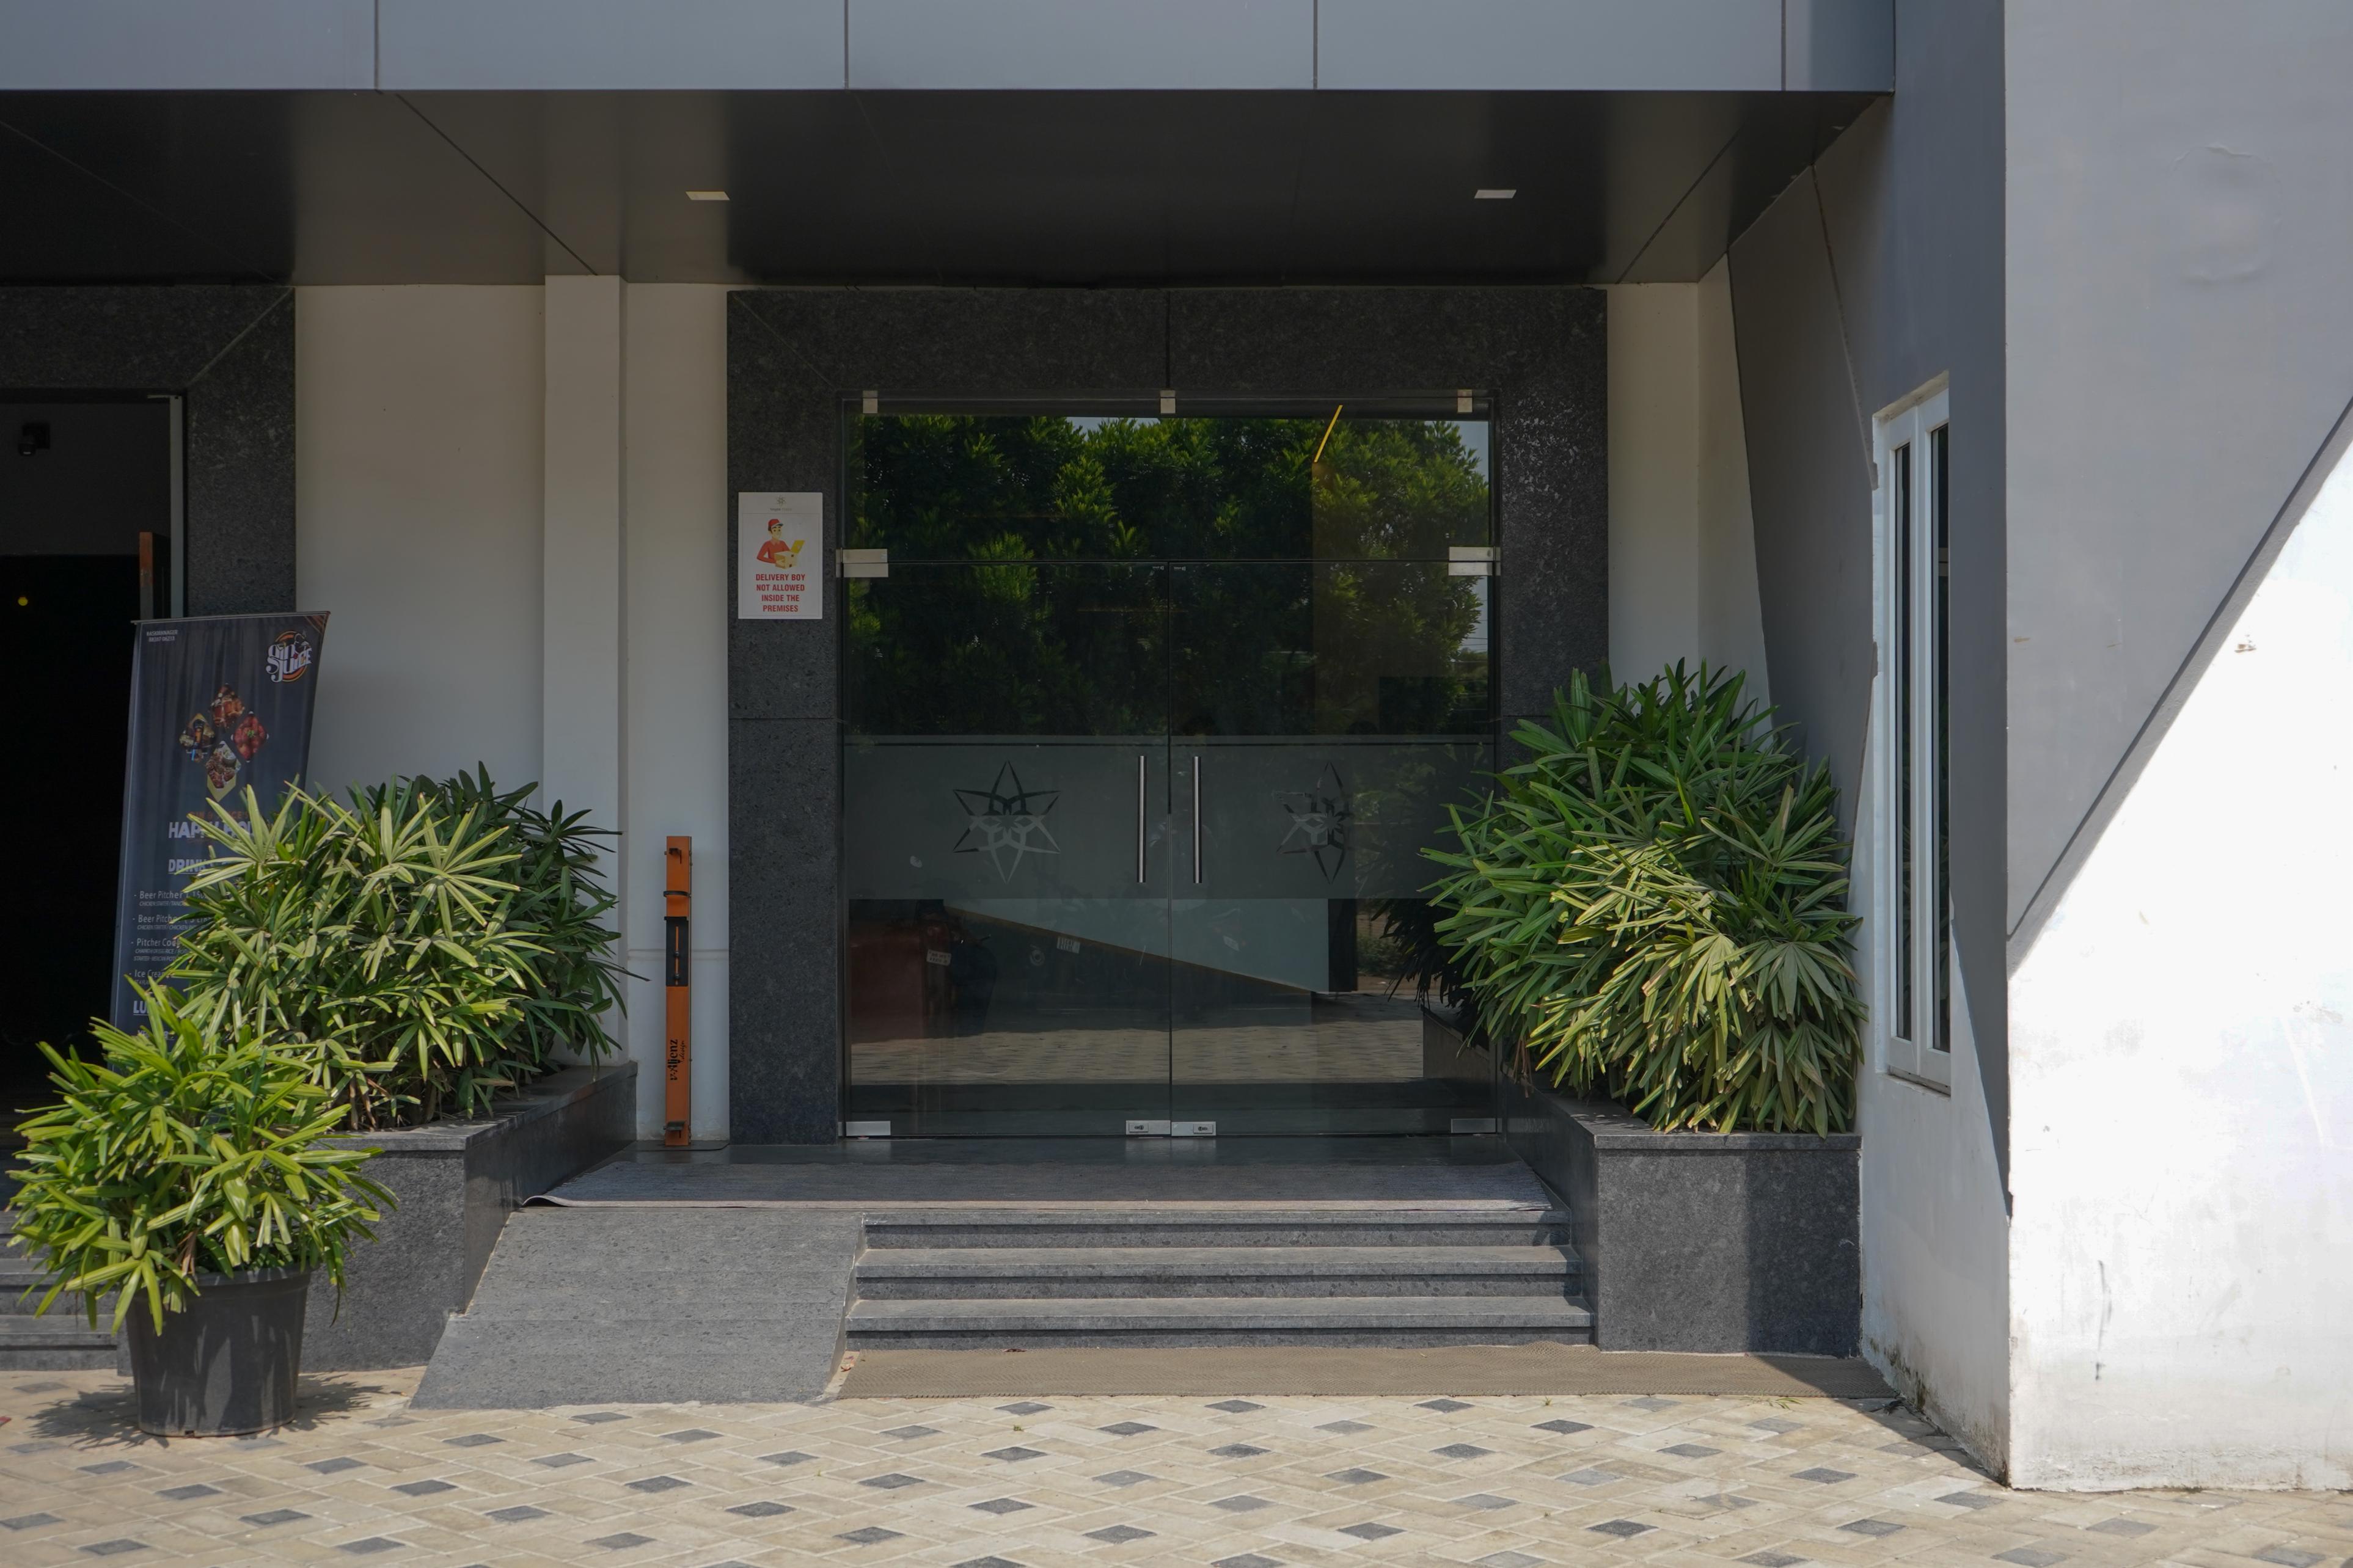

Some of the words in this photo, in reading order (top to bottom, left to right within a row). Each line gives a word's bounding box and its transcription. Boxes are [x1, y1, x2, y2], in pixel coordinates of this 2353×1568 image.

[169, 821, 219, 839] HAP
[139, 891, 156, 899] Beer
[158, 890, 183, 899] Pitcher
[138, 914, 154, 923] Beer
[156, 914, 180, 923] Pitch
[136, 938, 160, 947] Pitcher
[134, 969, 145, 978] Ice
